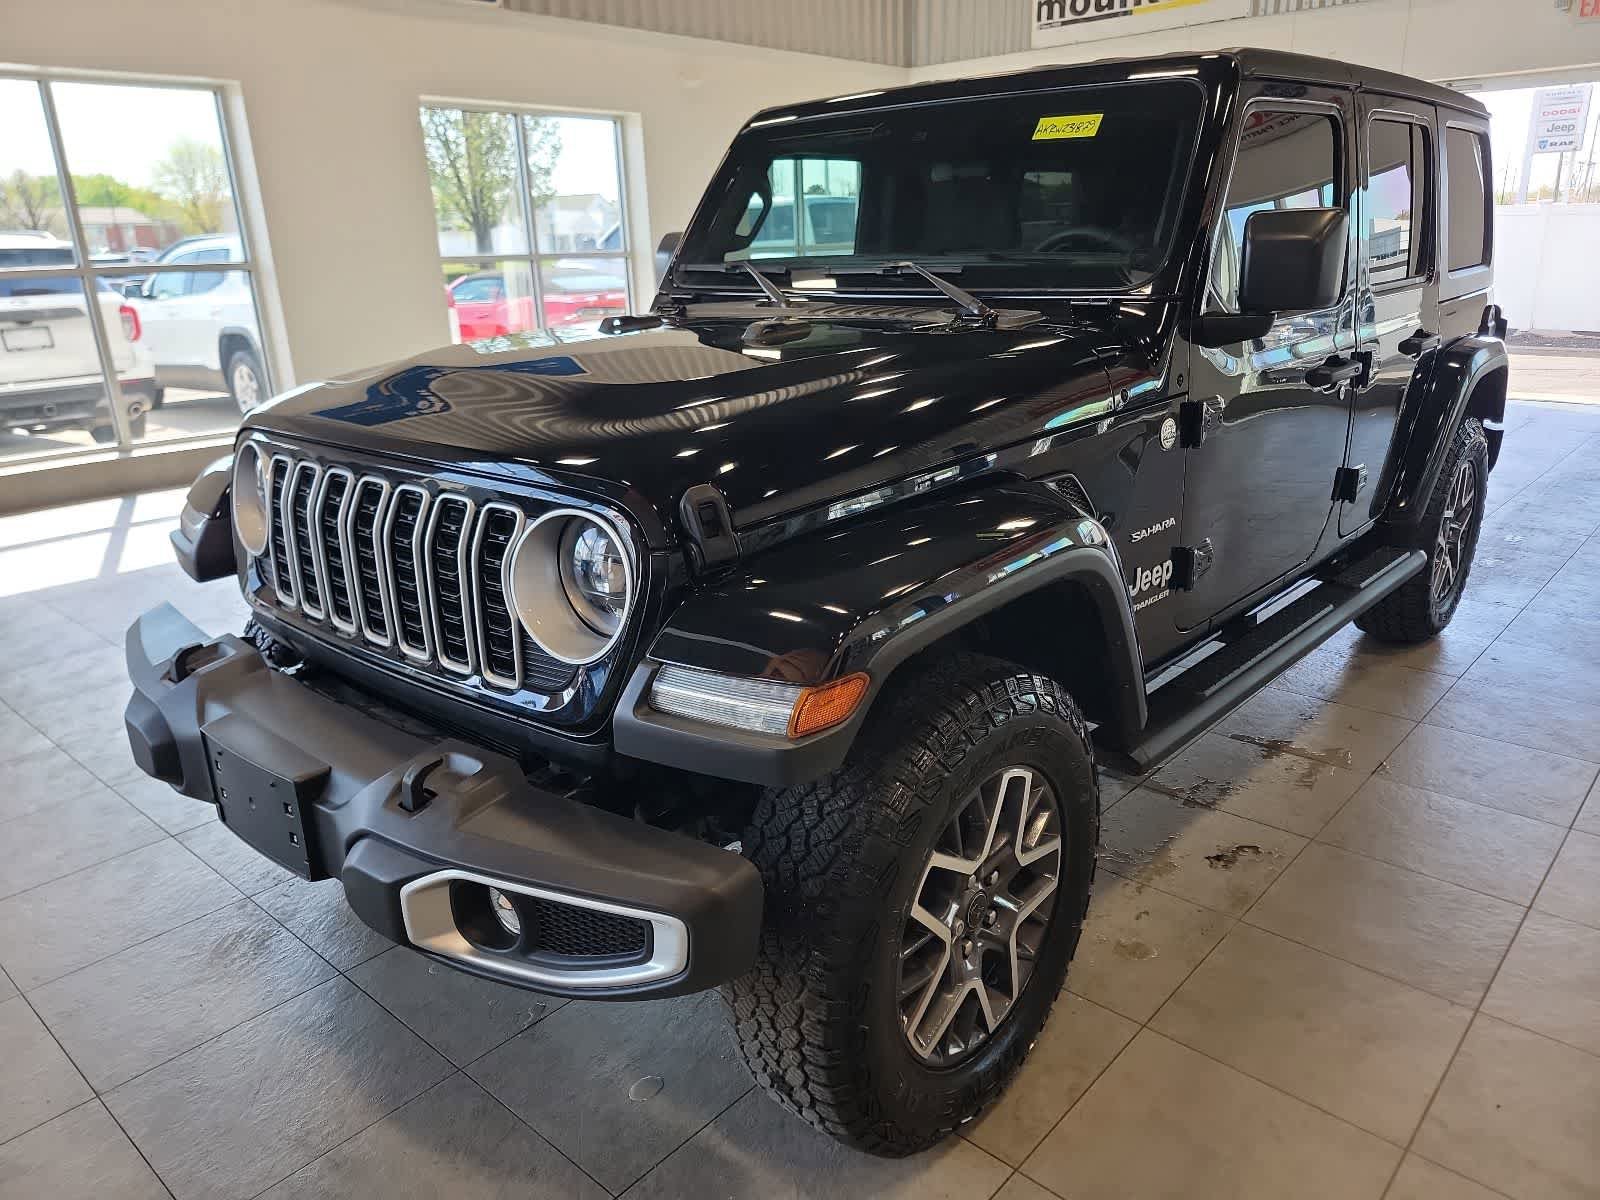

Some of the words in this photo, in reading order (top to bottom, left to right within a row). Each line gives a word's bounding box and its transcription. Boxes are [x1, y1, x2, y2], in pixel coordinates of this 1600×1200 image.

[1546, 122, 1576, 134] Jeep
[1131, 517, 1176, 543] SAHARA
[1128, 559, 1173, 597] Jeep
